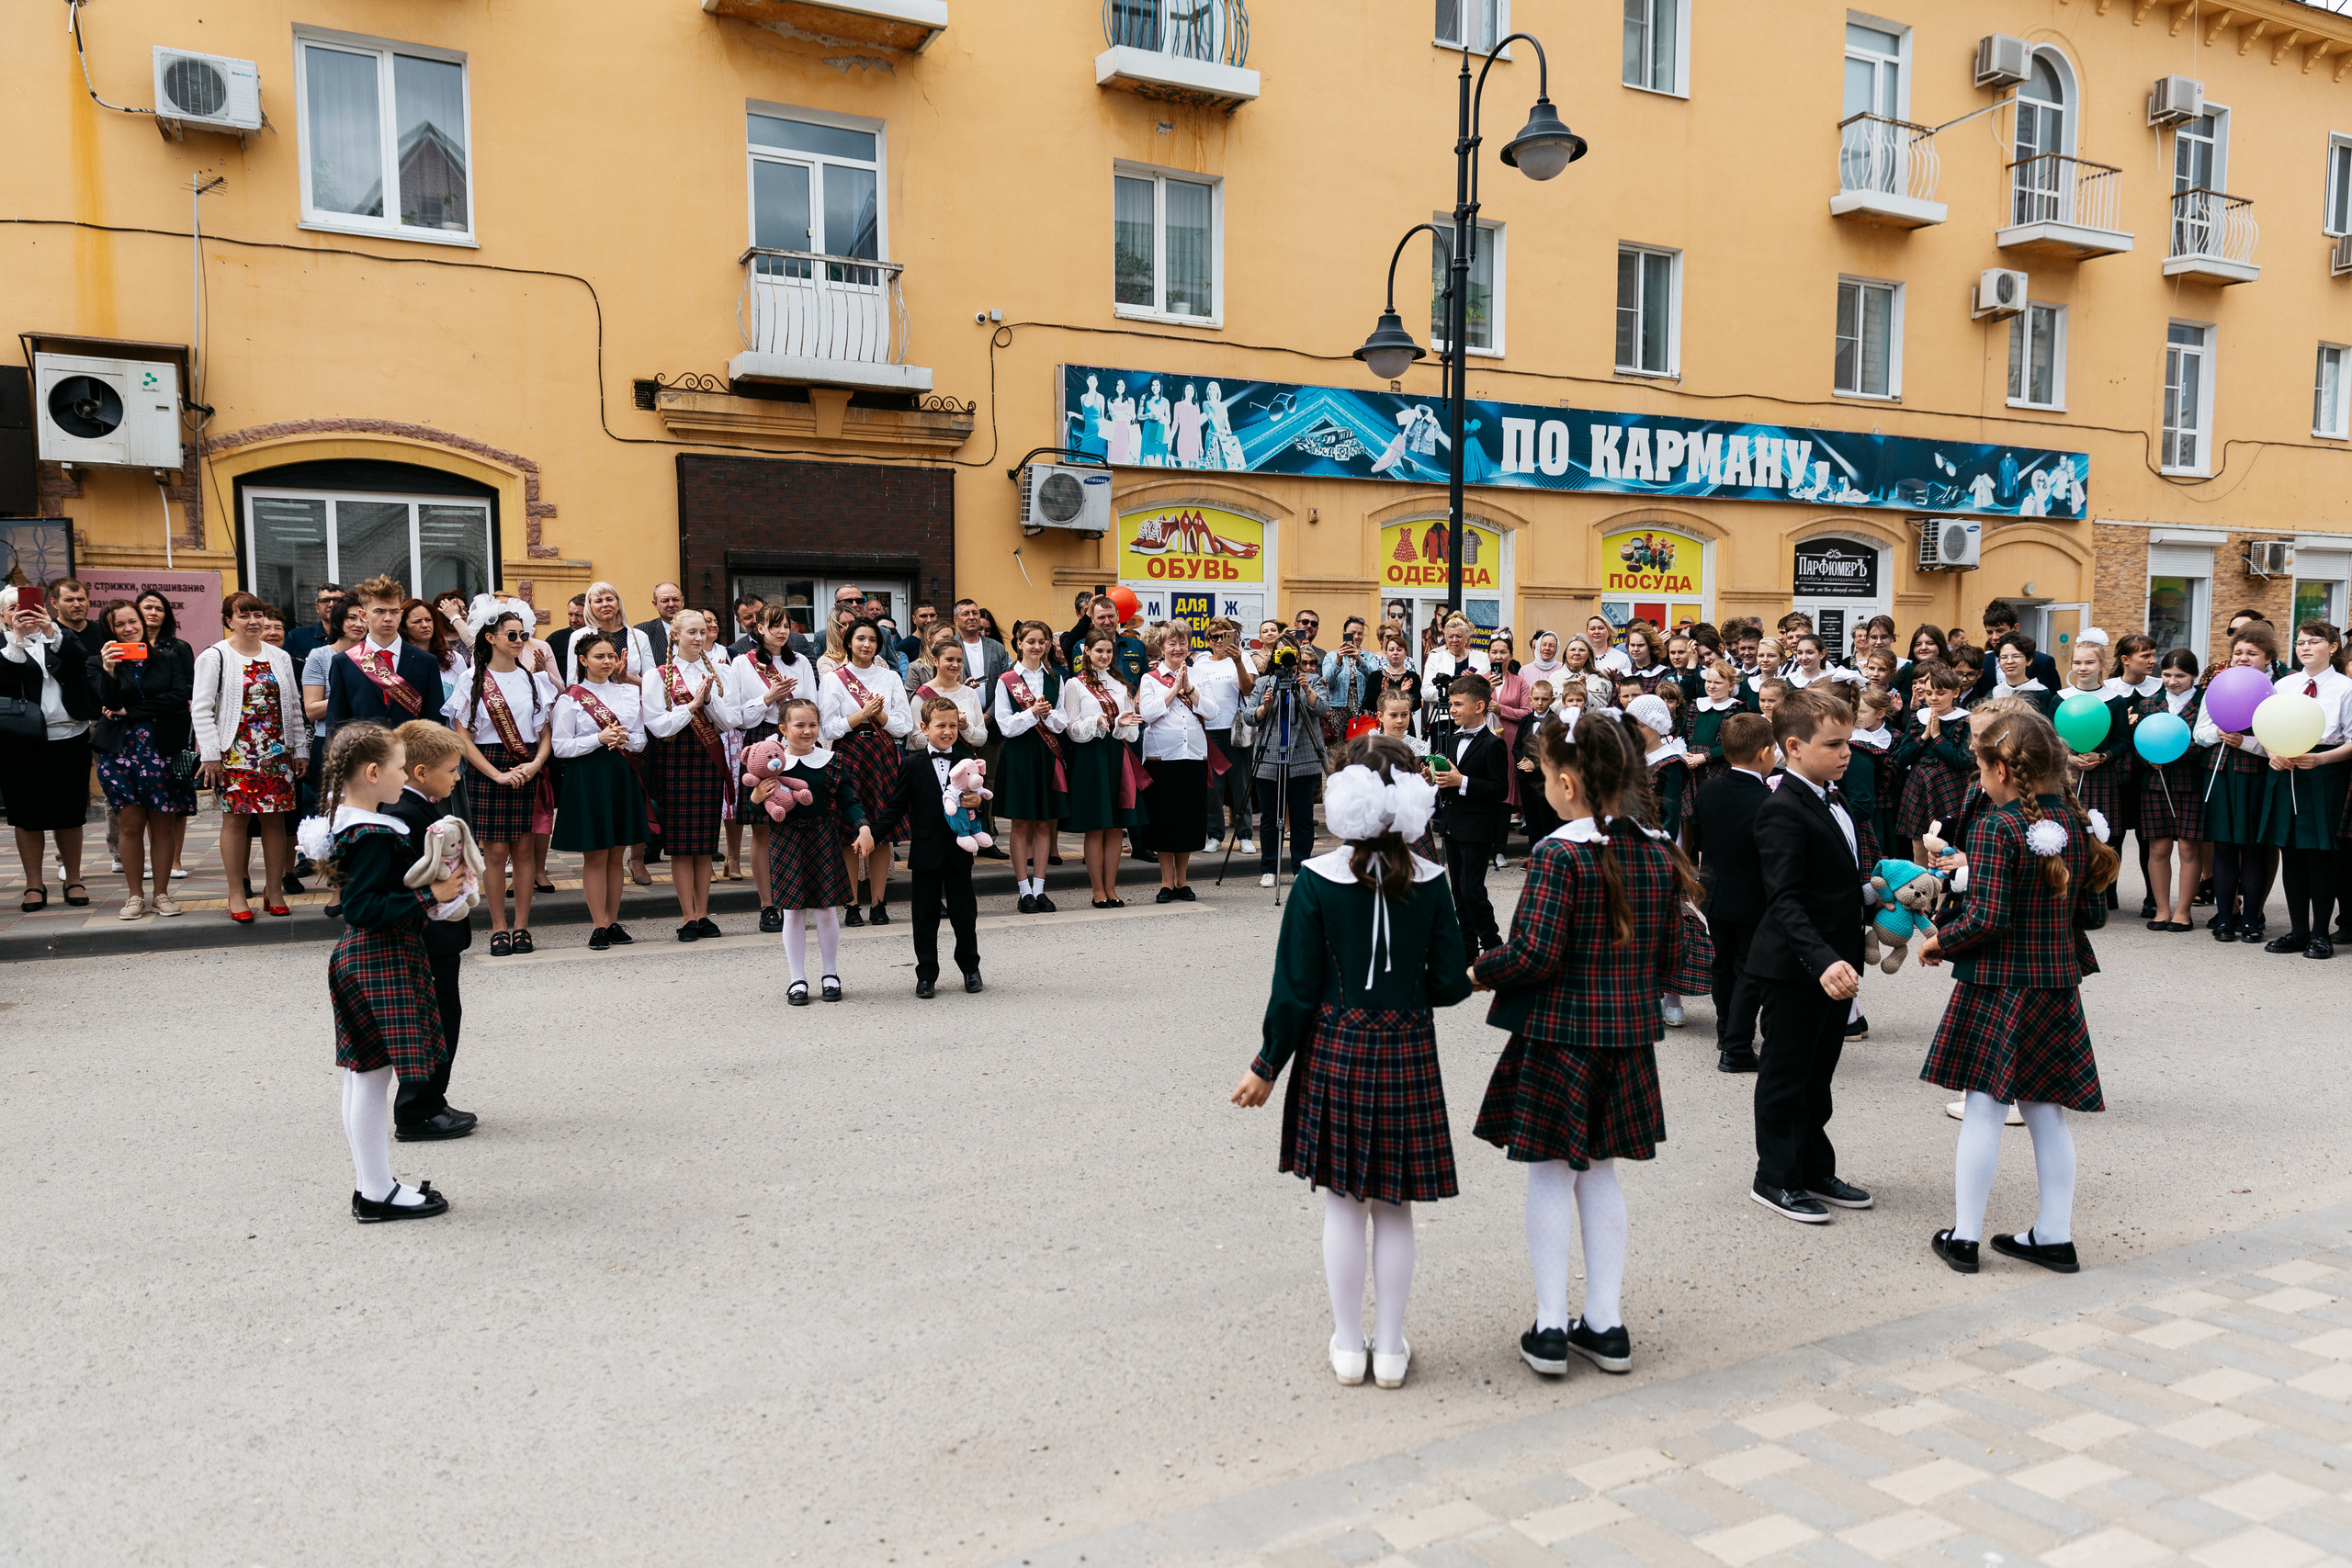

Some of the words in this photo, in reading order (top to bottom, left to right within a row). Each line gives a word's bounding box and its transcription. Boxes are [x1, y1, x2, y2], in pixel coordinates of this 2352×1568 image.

[1501, 416, 1569, 476] ПО
[1589, 423, 1812, 490] КАРМАНУ
[1147, 557, 1239, 580] ОБУВЬ
[95, 581, 139, 592] стрижки,
[141, 582, 205, 592] окрашивание
[1610, 573, 1692, 592] ПОСУДА
[1148, 602, 1160, 615] М
[1175, 598, 1207, 615] ДЛЯ
[1224, 601, 1238, 615] Ж
[1176, 614, 1211, 631] СЕЙ
